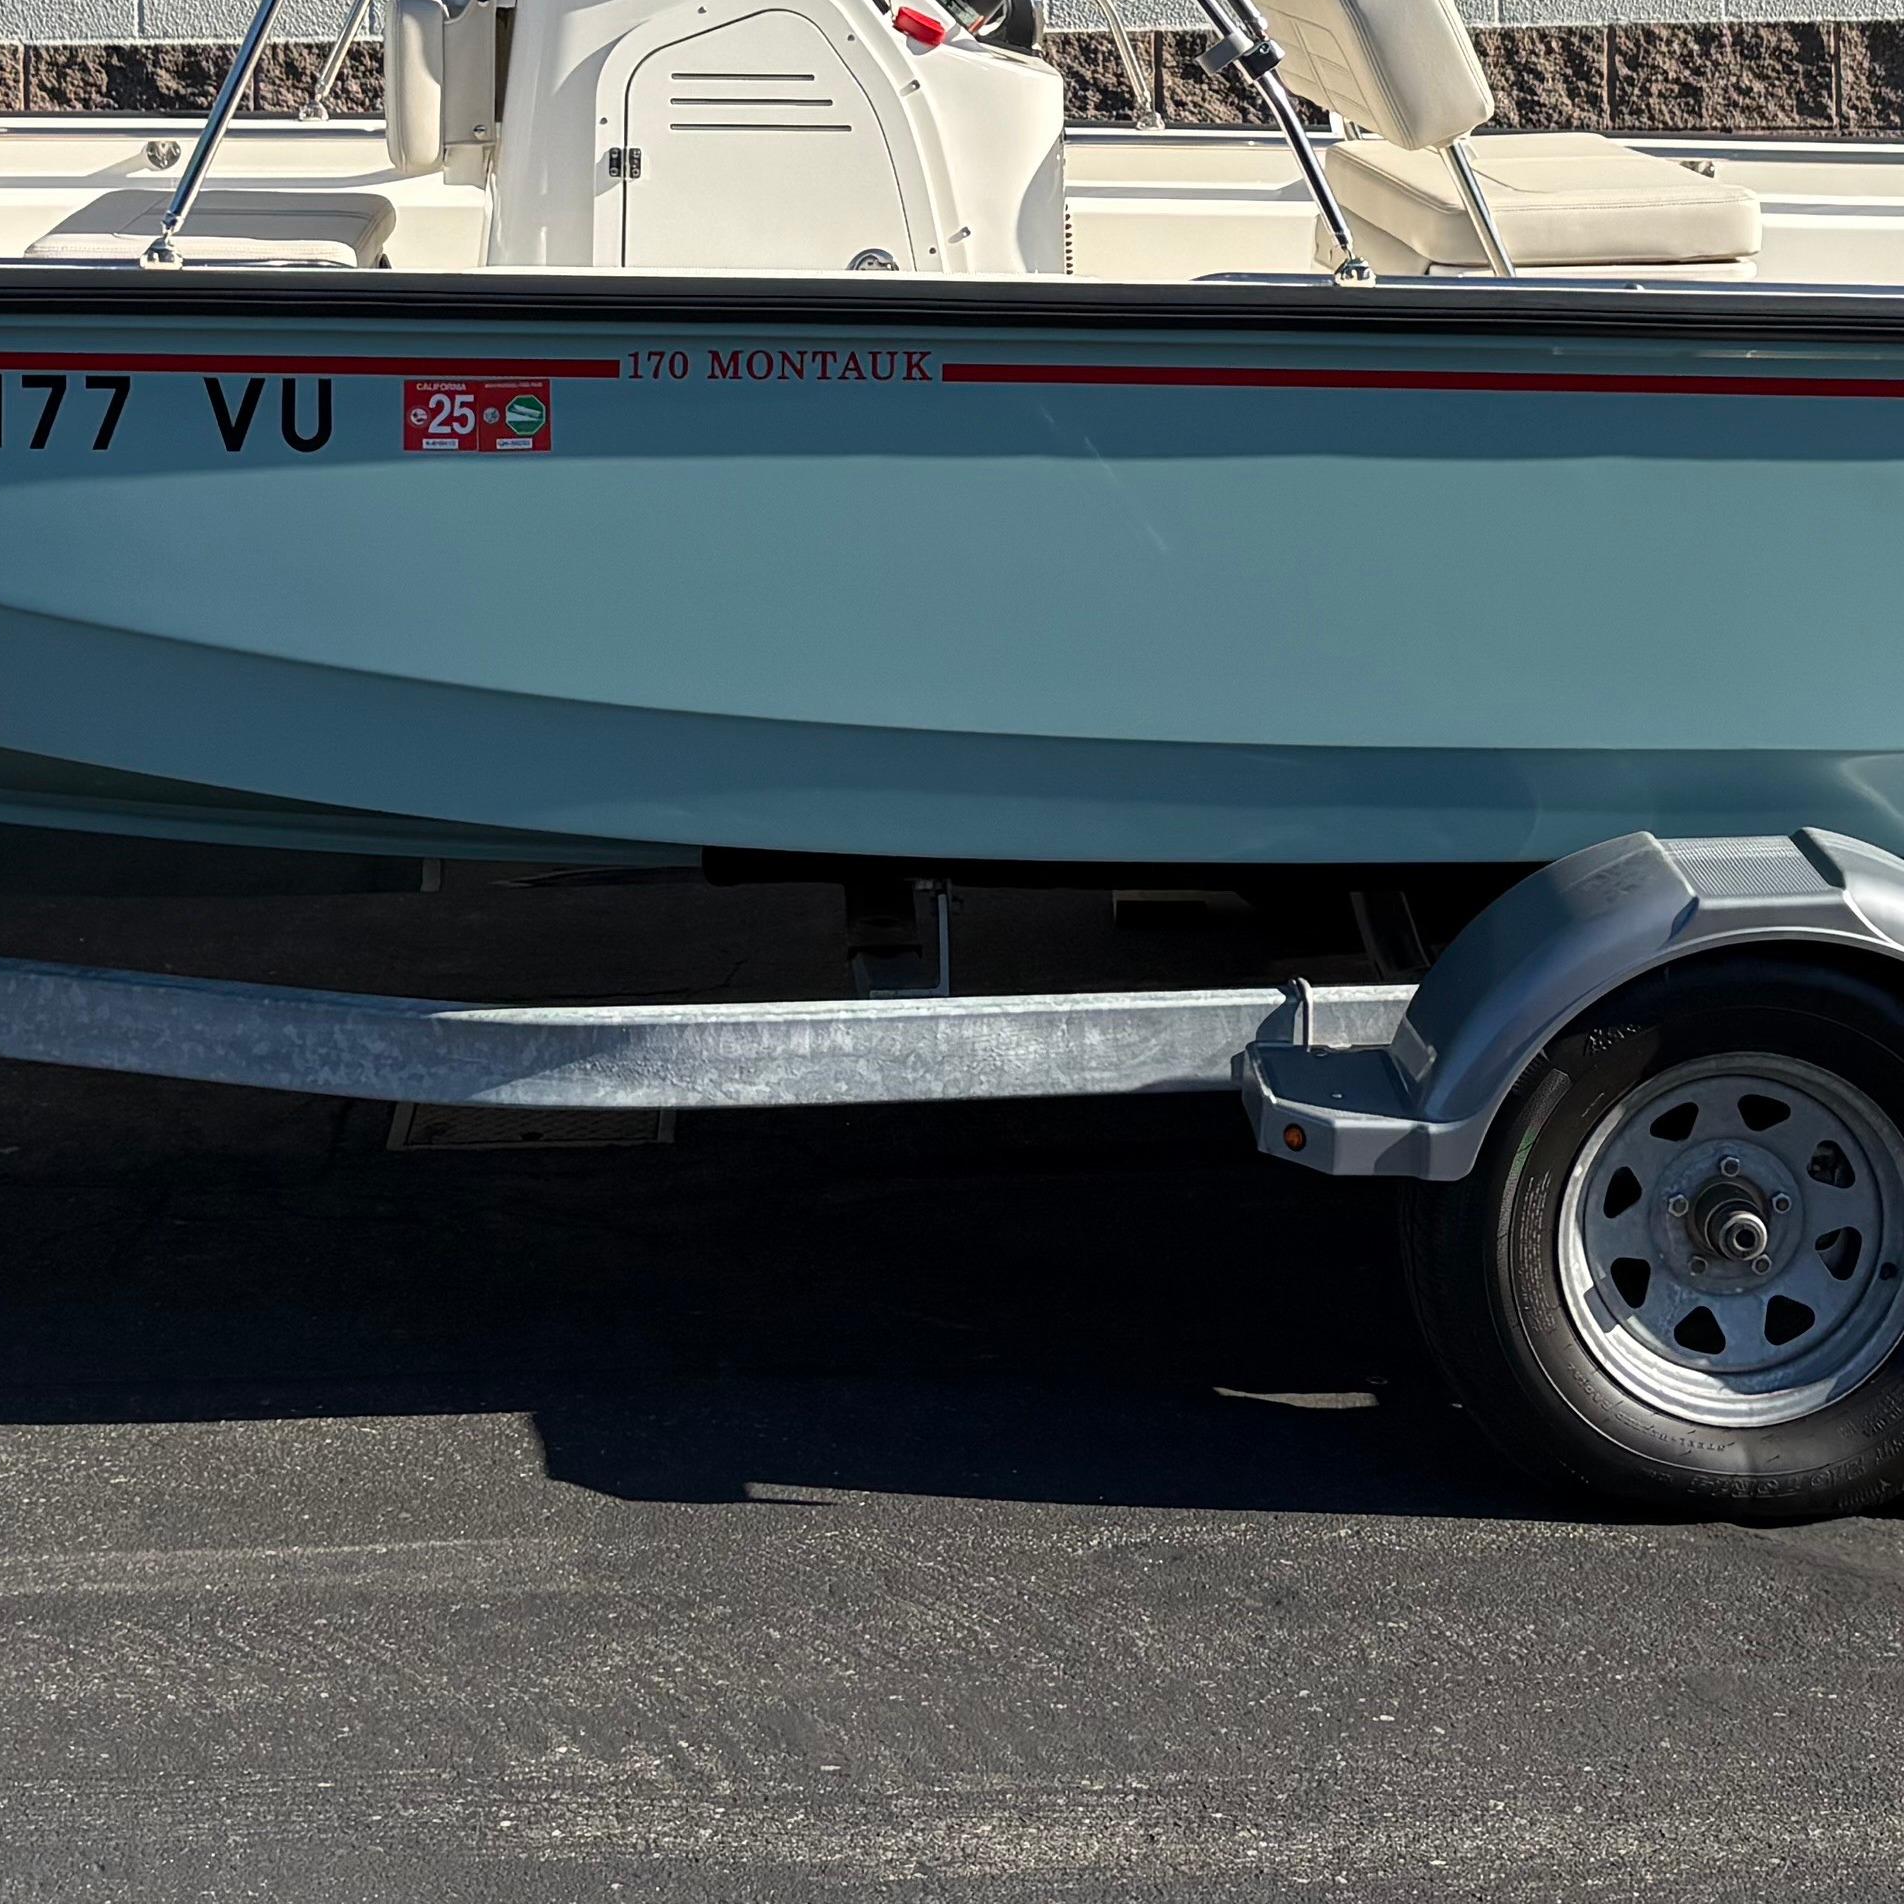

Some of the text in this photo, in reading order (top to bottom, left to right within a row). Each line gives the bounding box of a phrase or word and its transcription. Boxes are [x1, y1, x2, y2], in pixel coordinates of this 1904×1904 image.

[627, 350, 934, 383] 170 MONTAUK
[202, 376, 334, 453] VU
[428, 393, 476, 434] 25
